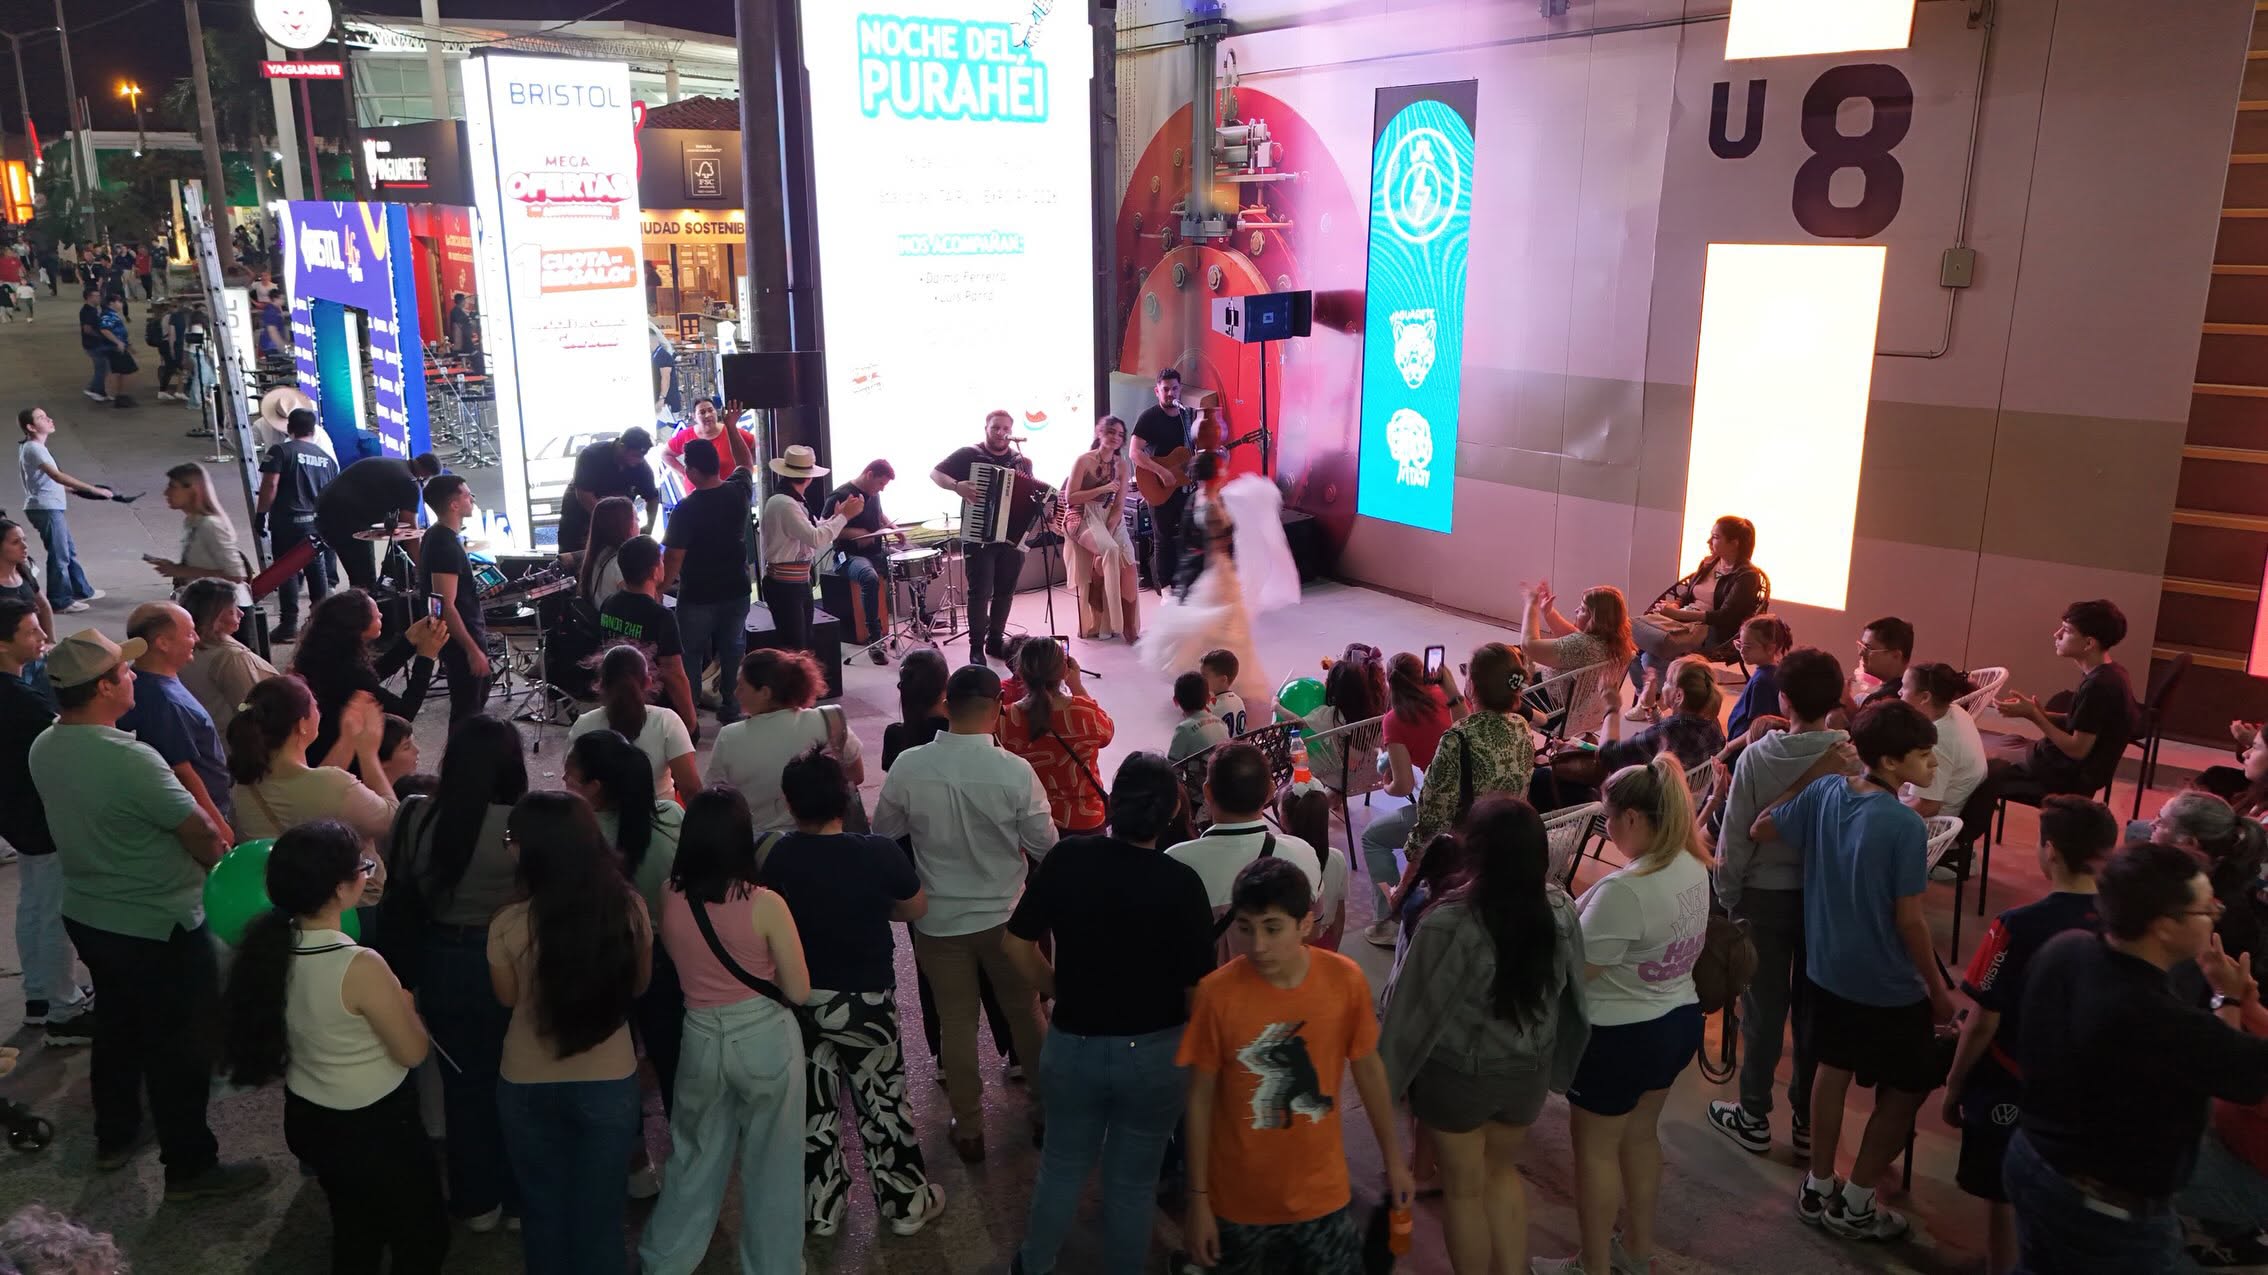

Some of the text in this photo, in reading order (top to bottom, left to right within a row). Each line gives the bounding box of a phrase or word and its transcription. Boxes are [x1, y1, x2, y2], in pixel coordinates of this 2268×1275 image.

[860, 20, 1017, 62] NOCHE DEL
[509, 82, 621, 108] BRISTOL
[862, 53, 1044, 117] PURAHÉI
[1708, 64, 1913, 239] U 8
[684, 222, 745, 235] SOSTENIB
[297, 452, 329, 468] STAFF
[1222, 710, 1247, 739] 10
